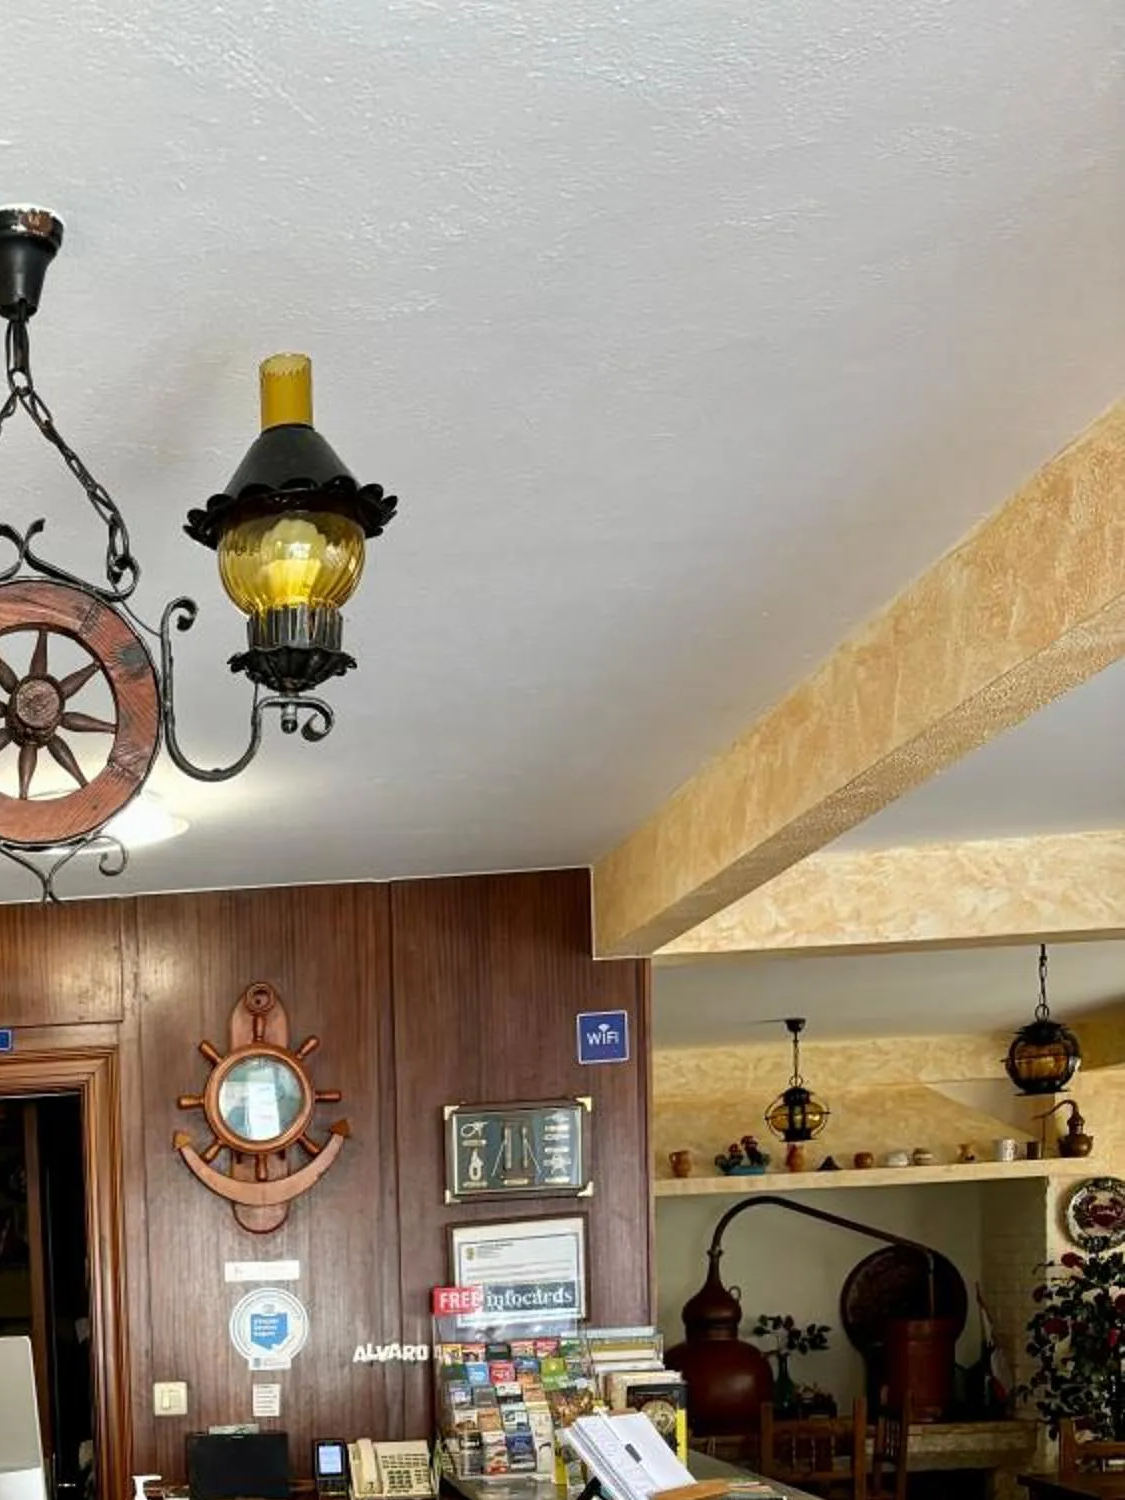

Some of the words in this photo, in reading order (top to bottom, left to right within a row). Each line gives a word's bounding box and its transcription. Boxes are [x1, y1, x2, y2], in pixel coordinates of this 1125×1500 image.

[440, 1291, 481, 1309] FREE
[486, 1287, 573, 1313] infocards
[353, 1342, 430, 1364] ALVARO
